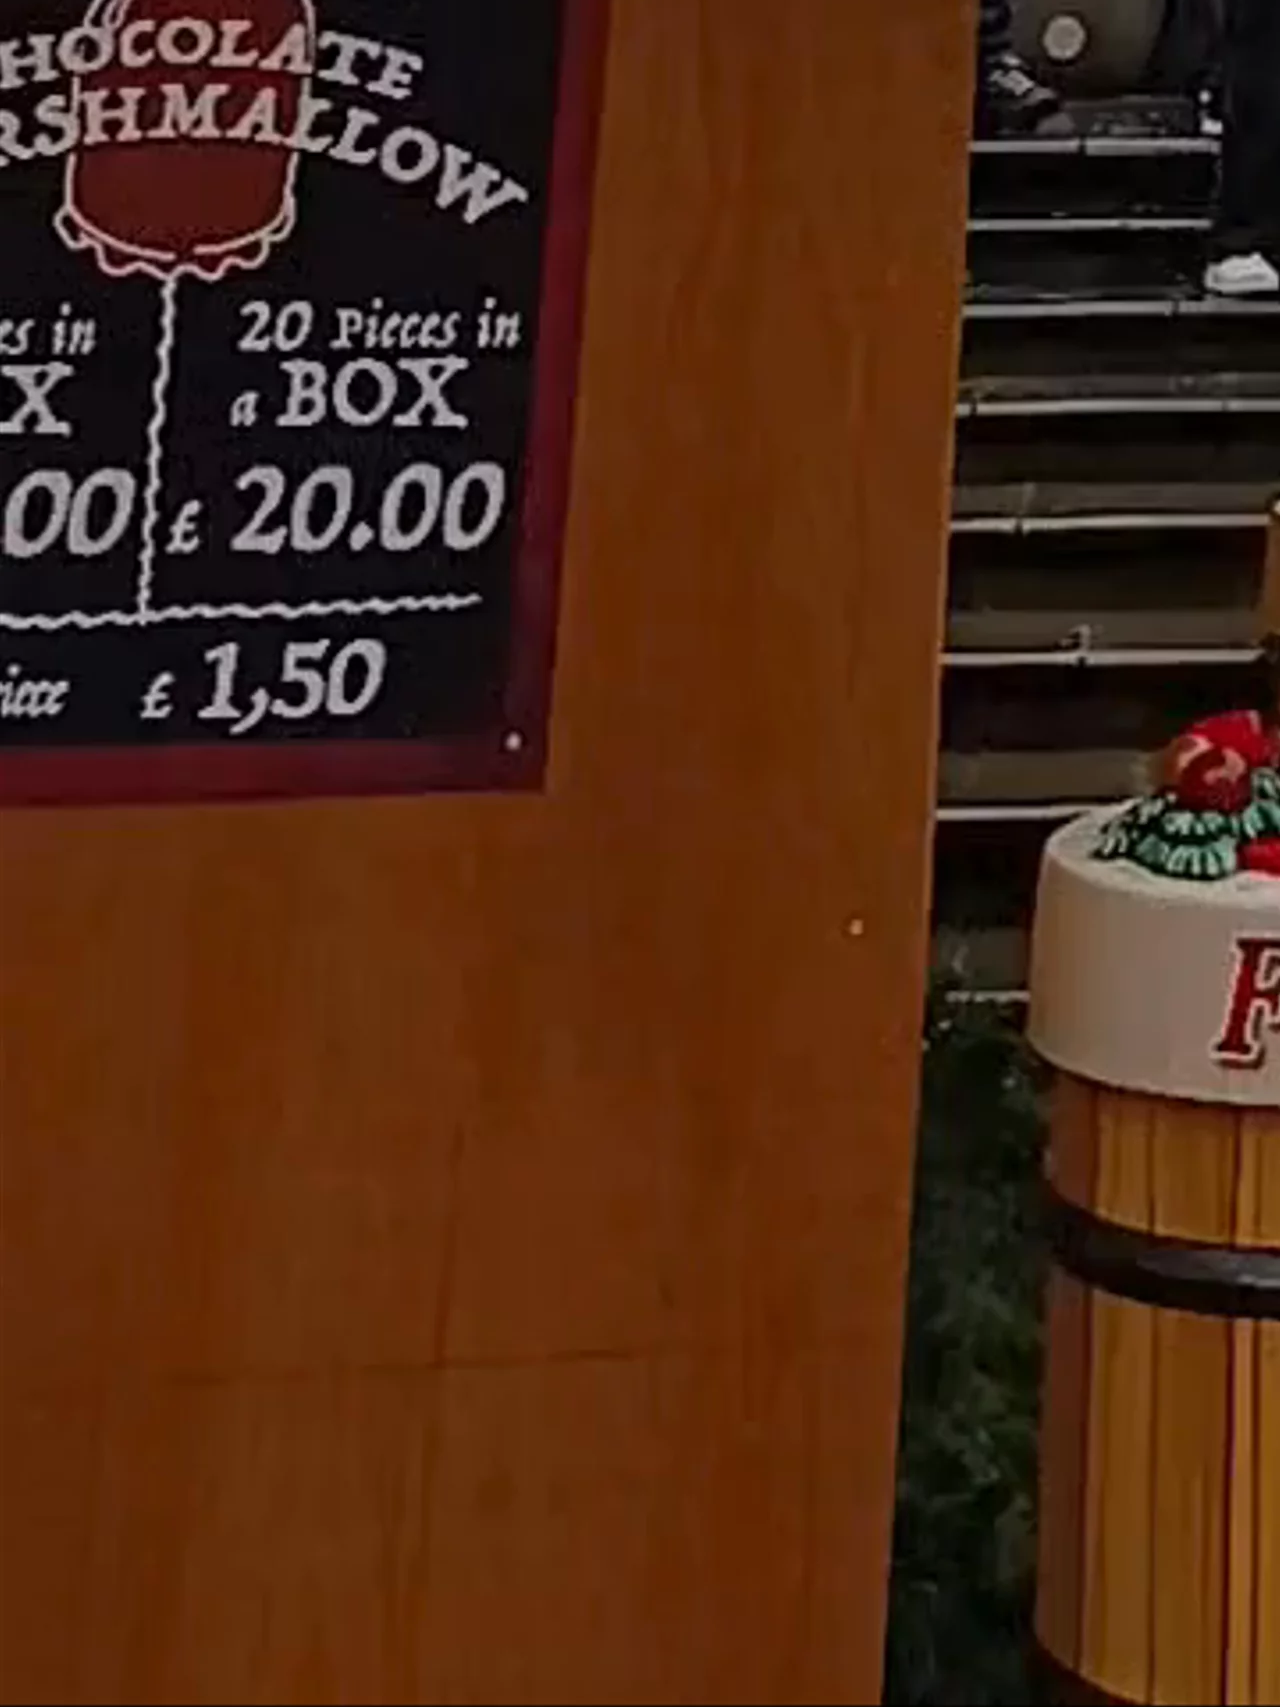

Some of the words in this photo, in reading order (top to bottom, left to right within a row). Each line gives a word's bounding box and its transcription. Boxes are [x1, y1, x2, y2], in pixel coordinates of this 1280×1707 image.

[52, 302, 97, 356] in
[236, 299, 315, 353] 20
[329, 297, 461, 351] Pieces
[477, 297, 521, 351] in
[230, 390, 261, 427] a
[275, 355, 470, 428] BOX
[165, 499, 203, 555] £
[230, 461, 506, 553] 20.00
[139, 671, 175, 719] £
[197, 638, 388, 735] 1,50
